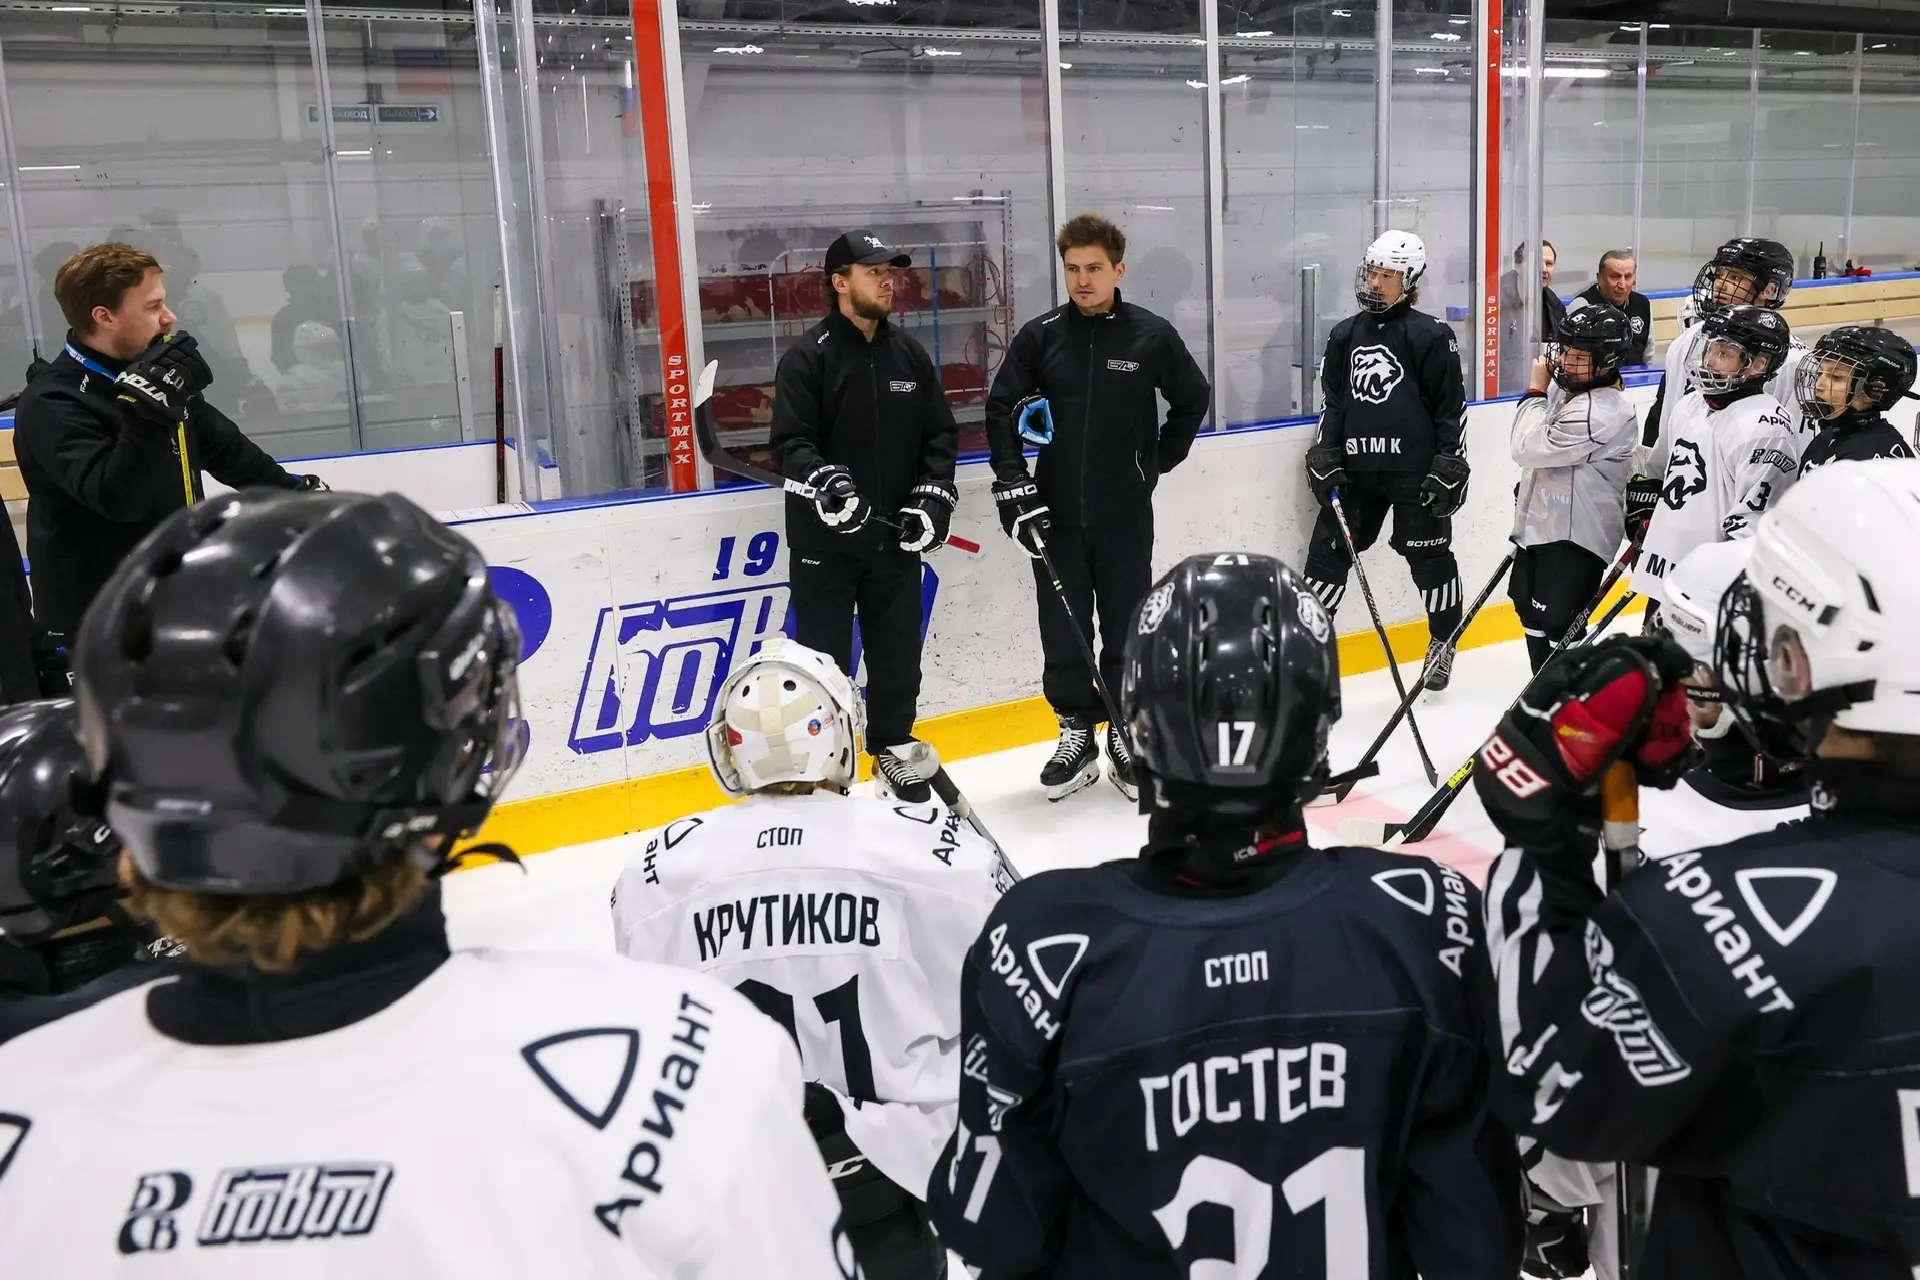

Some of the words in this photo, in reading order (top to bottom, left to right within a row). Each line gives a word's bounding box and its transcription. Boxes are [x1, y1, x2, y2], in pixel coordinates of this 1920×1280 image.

[1485, 295, 1498, 378] SPORTMAX
[667, 355, 693, 466] SPORTMAX
[1628, 491, 1660, 504] RIOR
[1772, 576, 1816, 613] CCM
[1217, 721, 1257, 767] 17
[756, 826, 804, 849] СТОП
[693, 892, 882, 962] КРУТИКОВ
[1659, 851, 1796, 1014] Ариант
[989, 922, 1061, 1042] Ариан
[1204, 950, 1269, 988] СТОП
[594, 992, 714, 1239] Ариант
[1139, 1041, 1347, 1152] ГОСТЕВ
